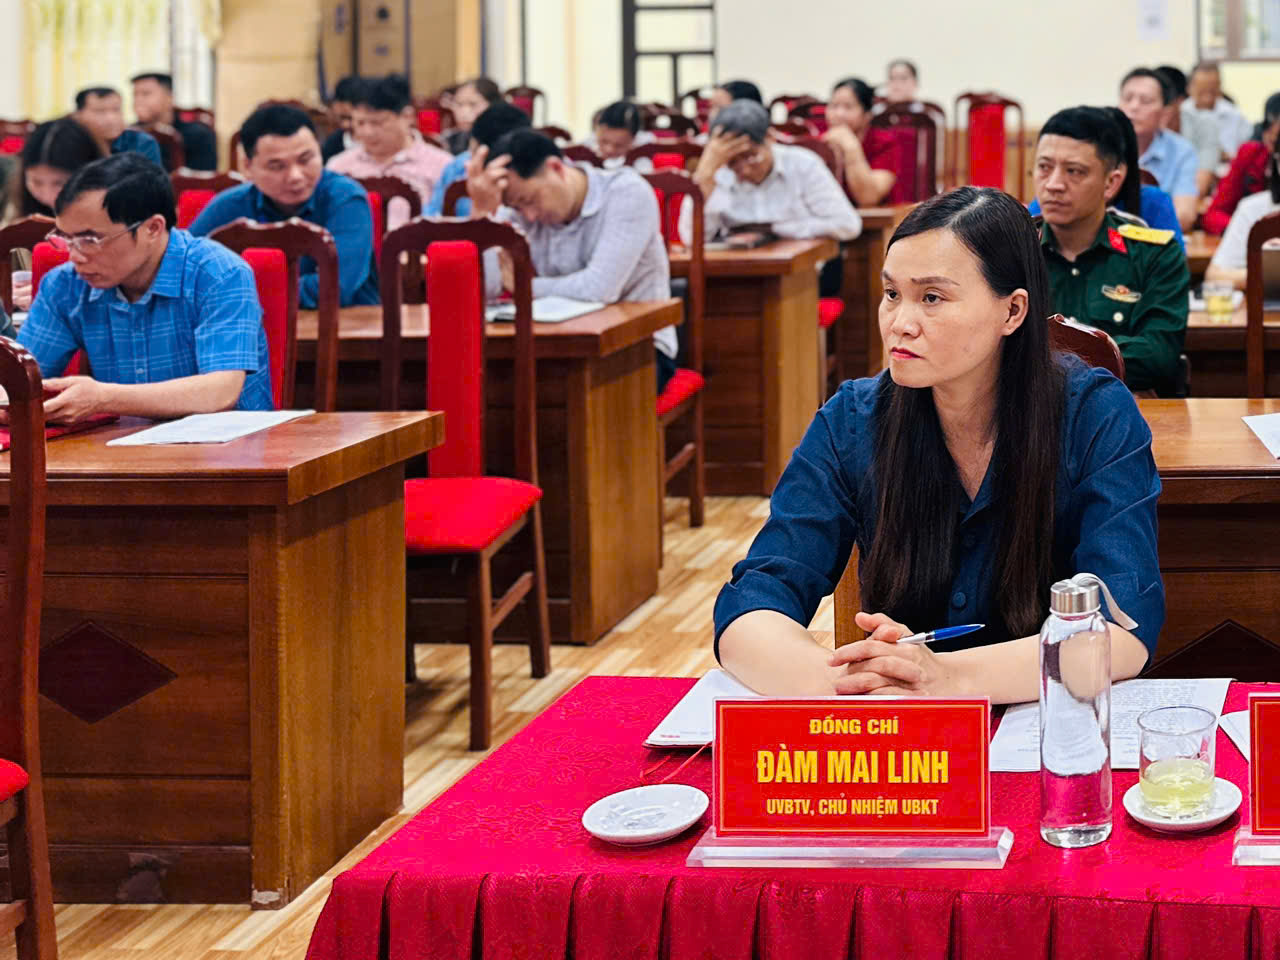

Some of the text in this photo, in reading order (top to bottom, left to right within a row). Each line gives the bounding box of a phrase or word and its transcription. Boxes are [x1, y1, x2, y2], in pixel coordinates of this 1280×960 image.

[866, 716, 899, 735] CHÍ
[756, 743, 949, 784] ĐÀM MAI LINH
[766, 793, 939, 818] UVBTV, CHỦ NHIỆM UBKT
